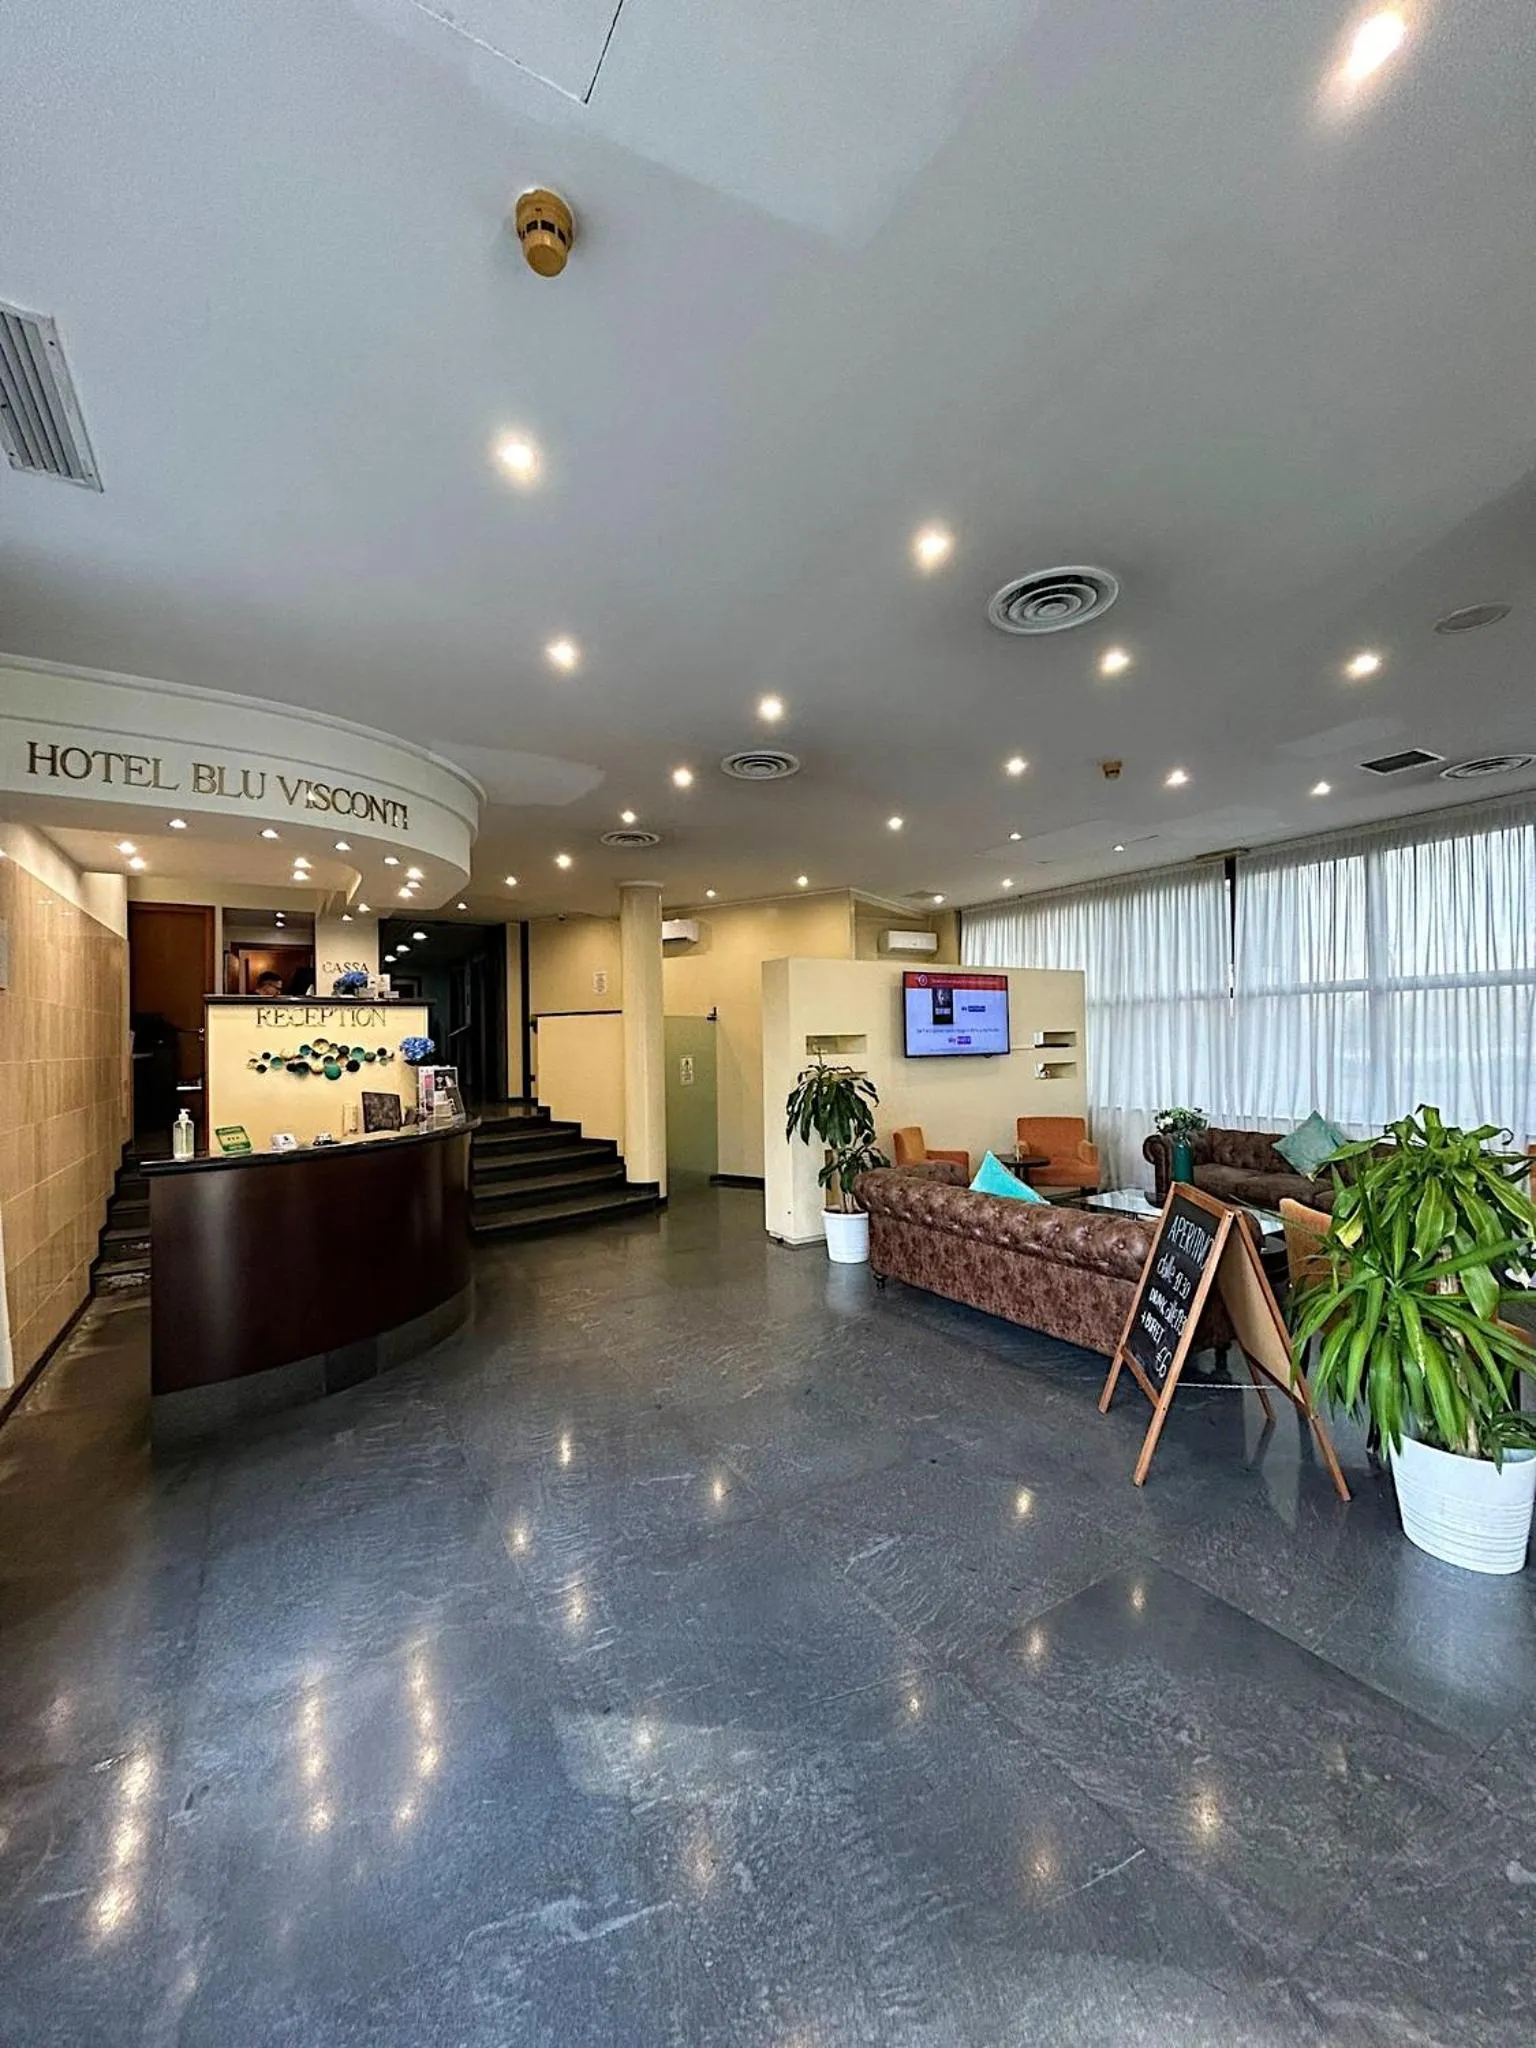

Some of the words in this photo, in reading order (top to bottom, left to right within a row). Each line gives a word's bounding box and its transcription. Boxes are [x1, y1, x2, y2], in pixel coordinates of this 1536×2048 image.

[27, 741, 179, 791] HOTEL
[191, 762, 266, 800] BLU
[276, 775, 409, 831] VISCONTI
[322, 961, 369, 974] CASSA
[256, 1006, 387, 1028] RECEPTION
